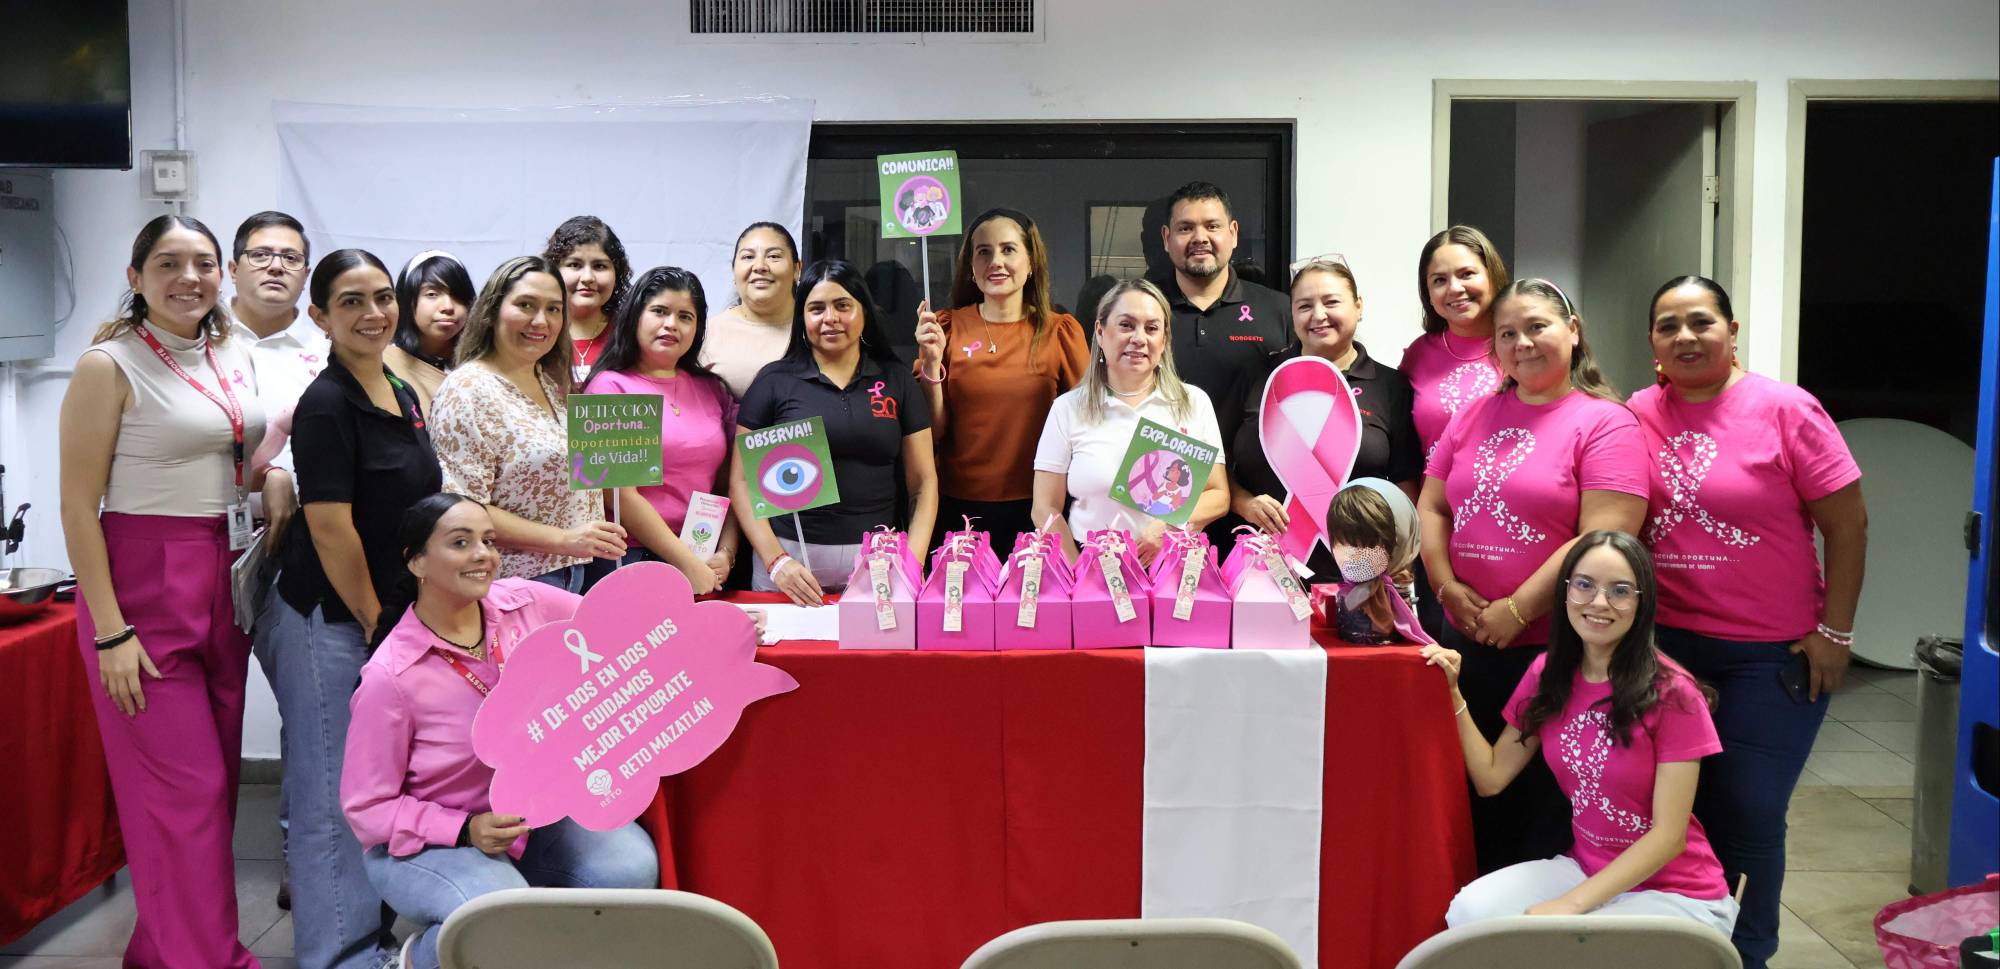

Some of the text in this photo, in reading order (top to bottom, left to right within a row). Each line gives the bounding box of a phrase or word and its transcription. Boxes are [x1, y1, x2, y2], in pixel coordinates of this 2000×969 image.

[881, 156, 955, 175] COMUNICA!!
[575, 403, 658, 419] DETECCIÓN
[570, 434, 659, 451] Oportunidad
[745, 421, 813, 450] OBSERVA!!
[1140, 425, 1214, 465] EXPLORATE!!
[589, 448, 648, 465] de Vida!!
[527, 719, 545, 744] #
[565, 680, 599, 712] DOS
[595, 663, 621, 689] EN
[616, 641, 649, 673] DOS
[645, 617, 678, 650] NOS
[581, 668, 655, 732] CUIDAMOS
[572, 669, 694, 773] MEJOR EXPLORATE
[618, 696, 715, 781] RETO MAZATLÁN
